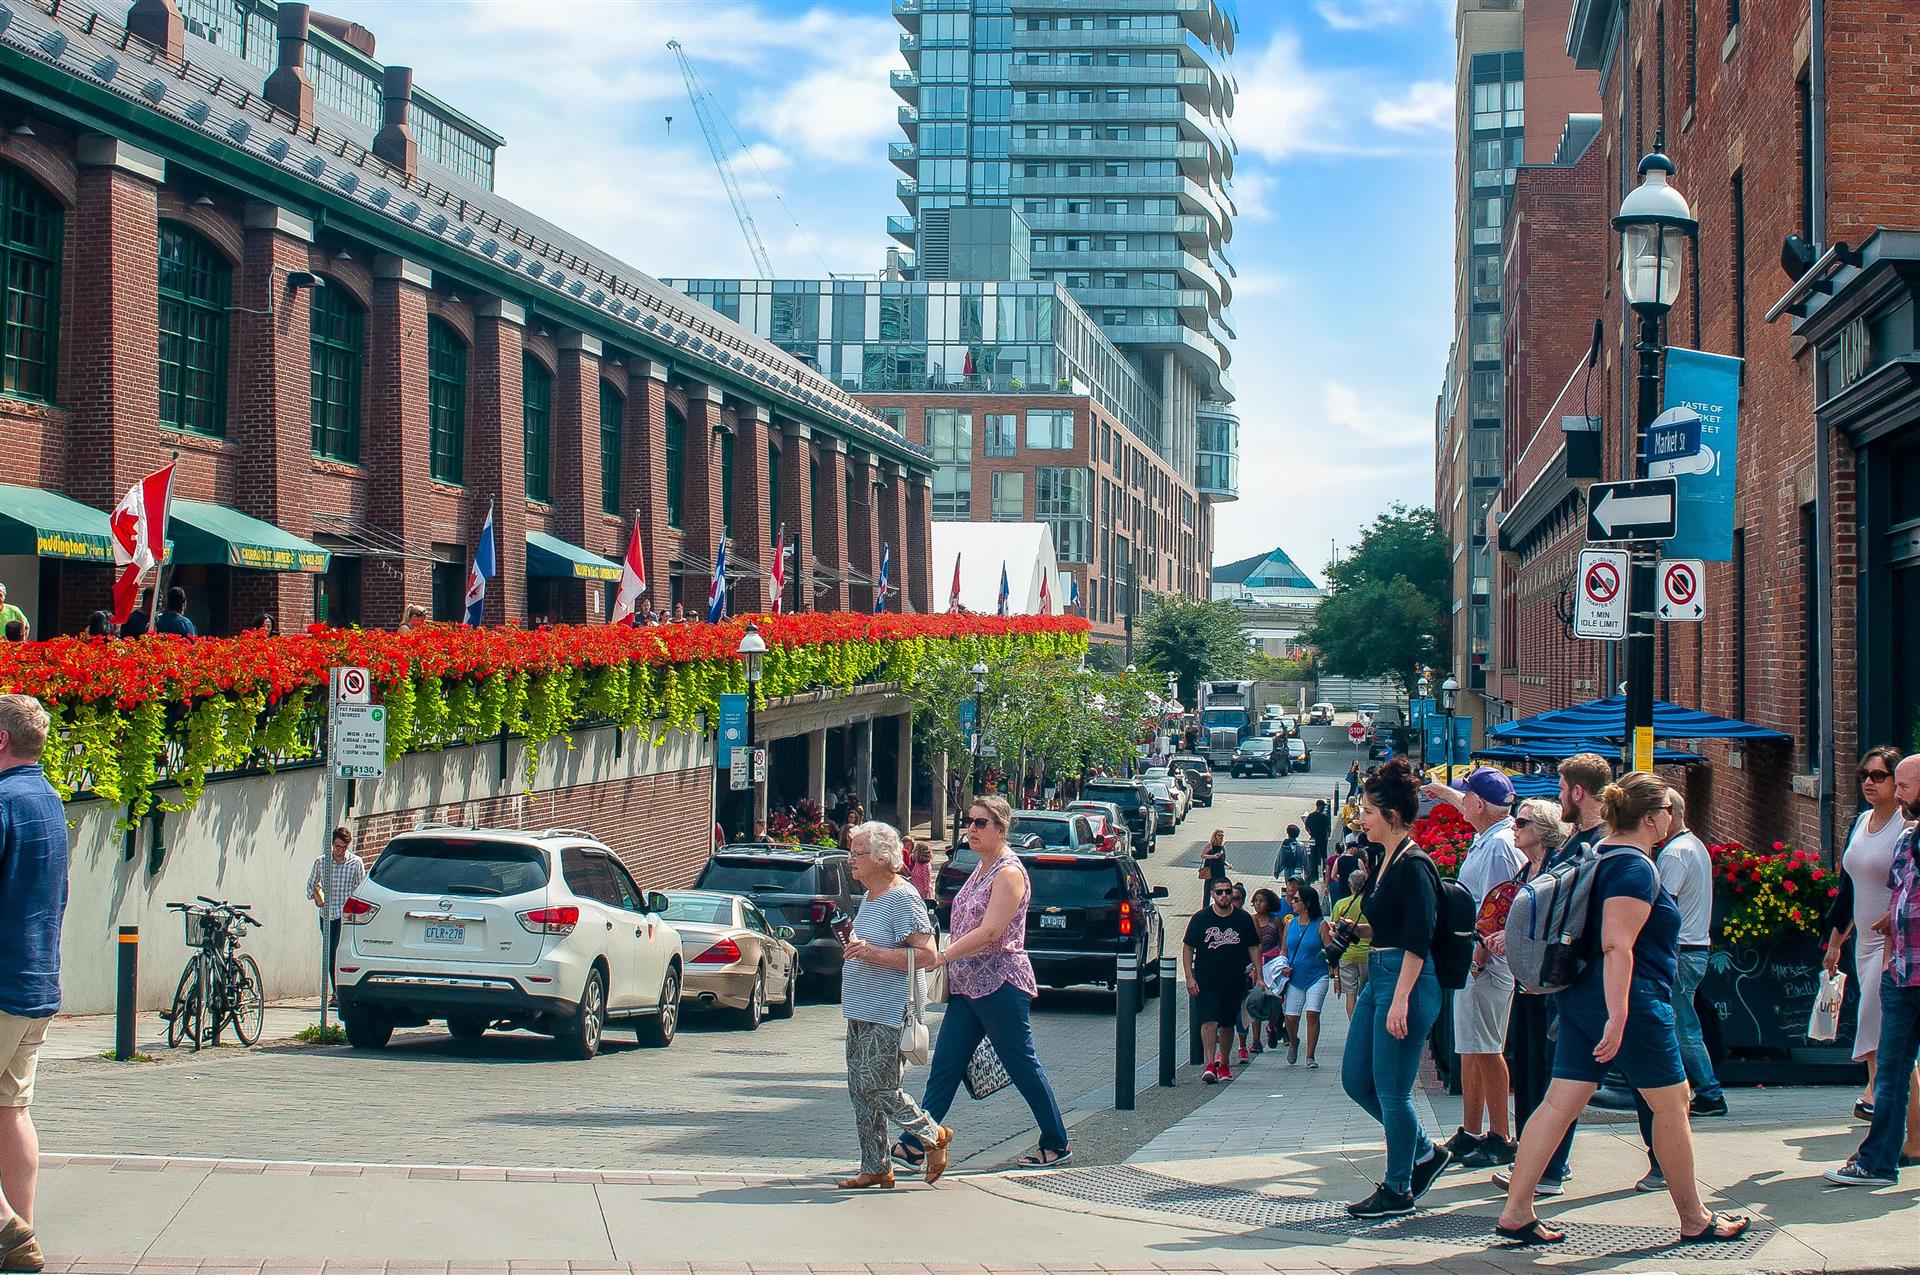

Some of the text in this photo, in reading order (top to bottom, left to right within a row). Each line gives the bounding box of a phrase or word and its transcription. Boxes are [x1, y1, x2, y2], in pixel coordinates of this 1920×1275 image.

[1680, 400, 1723, 413] TASTE OF
[1697, 414, 1722, 424] RKET
[1701, 425, 1720, 434] EET
[1654, 430, 1686, 455] Market St
[1589, 556, 1617, 567] NO IDLING
[1585, 597, 1609, 608] CHAPTER
[1596, 611, 1610, 619] MIN
[1580, 619, 1619, 628] IDLE LIMIT
[353, 765, 375, 774] 4130
